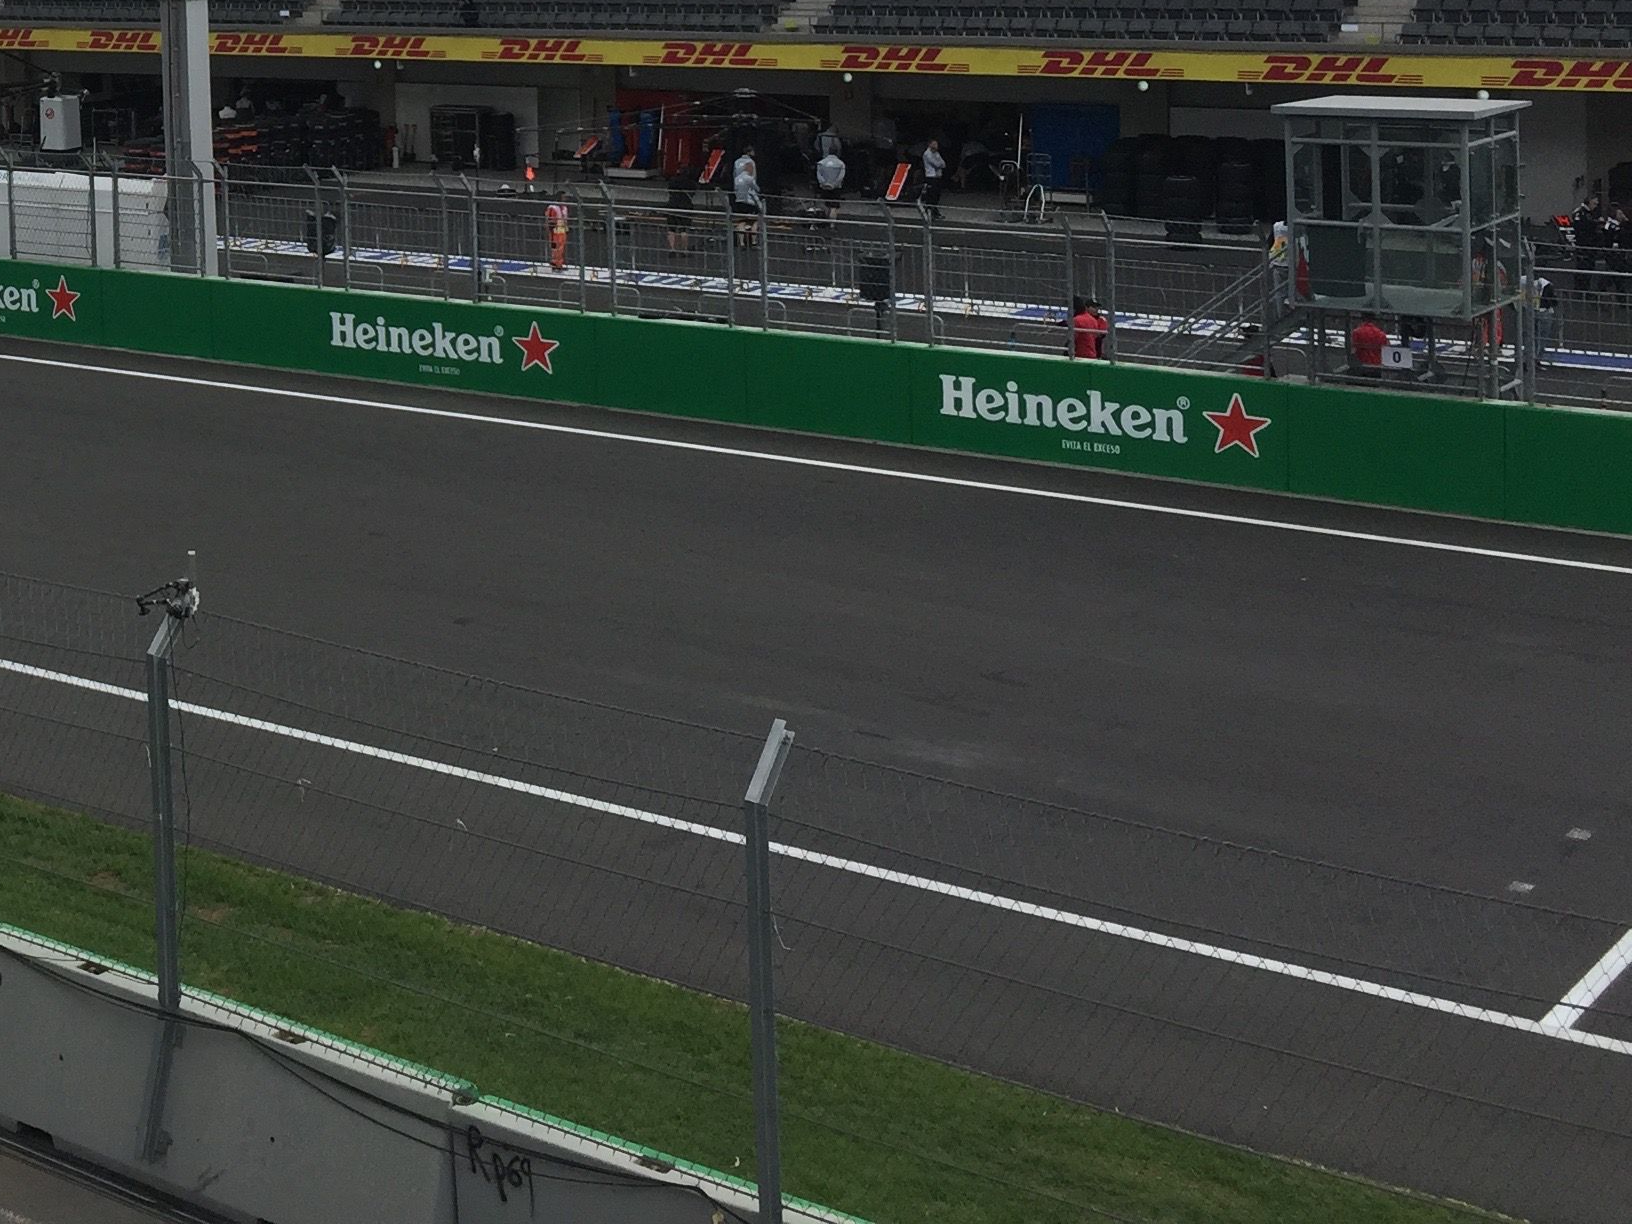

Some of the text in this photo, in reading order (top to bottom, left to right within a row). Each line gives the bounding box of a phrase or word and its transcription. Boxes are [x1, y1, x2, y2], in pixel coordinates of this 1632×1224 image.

[89, 31, 157, 50] DHL
[215, 34, 288, 53] DHL
[350, 36, 431, 57] DHL
[499, 39, 585, 61] DHL
[660, 42, 758, 66] DHL
[839, 46, 949, 72] DHL
[1040, 50, 1162, 77] DHL
[1262, 56, 1398, 84] DHL
[1392, 350, 1401, 364] 0
[1061, 439, 1121, 455] EVITA EL EXCESO
